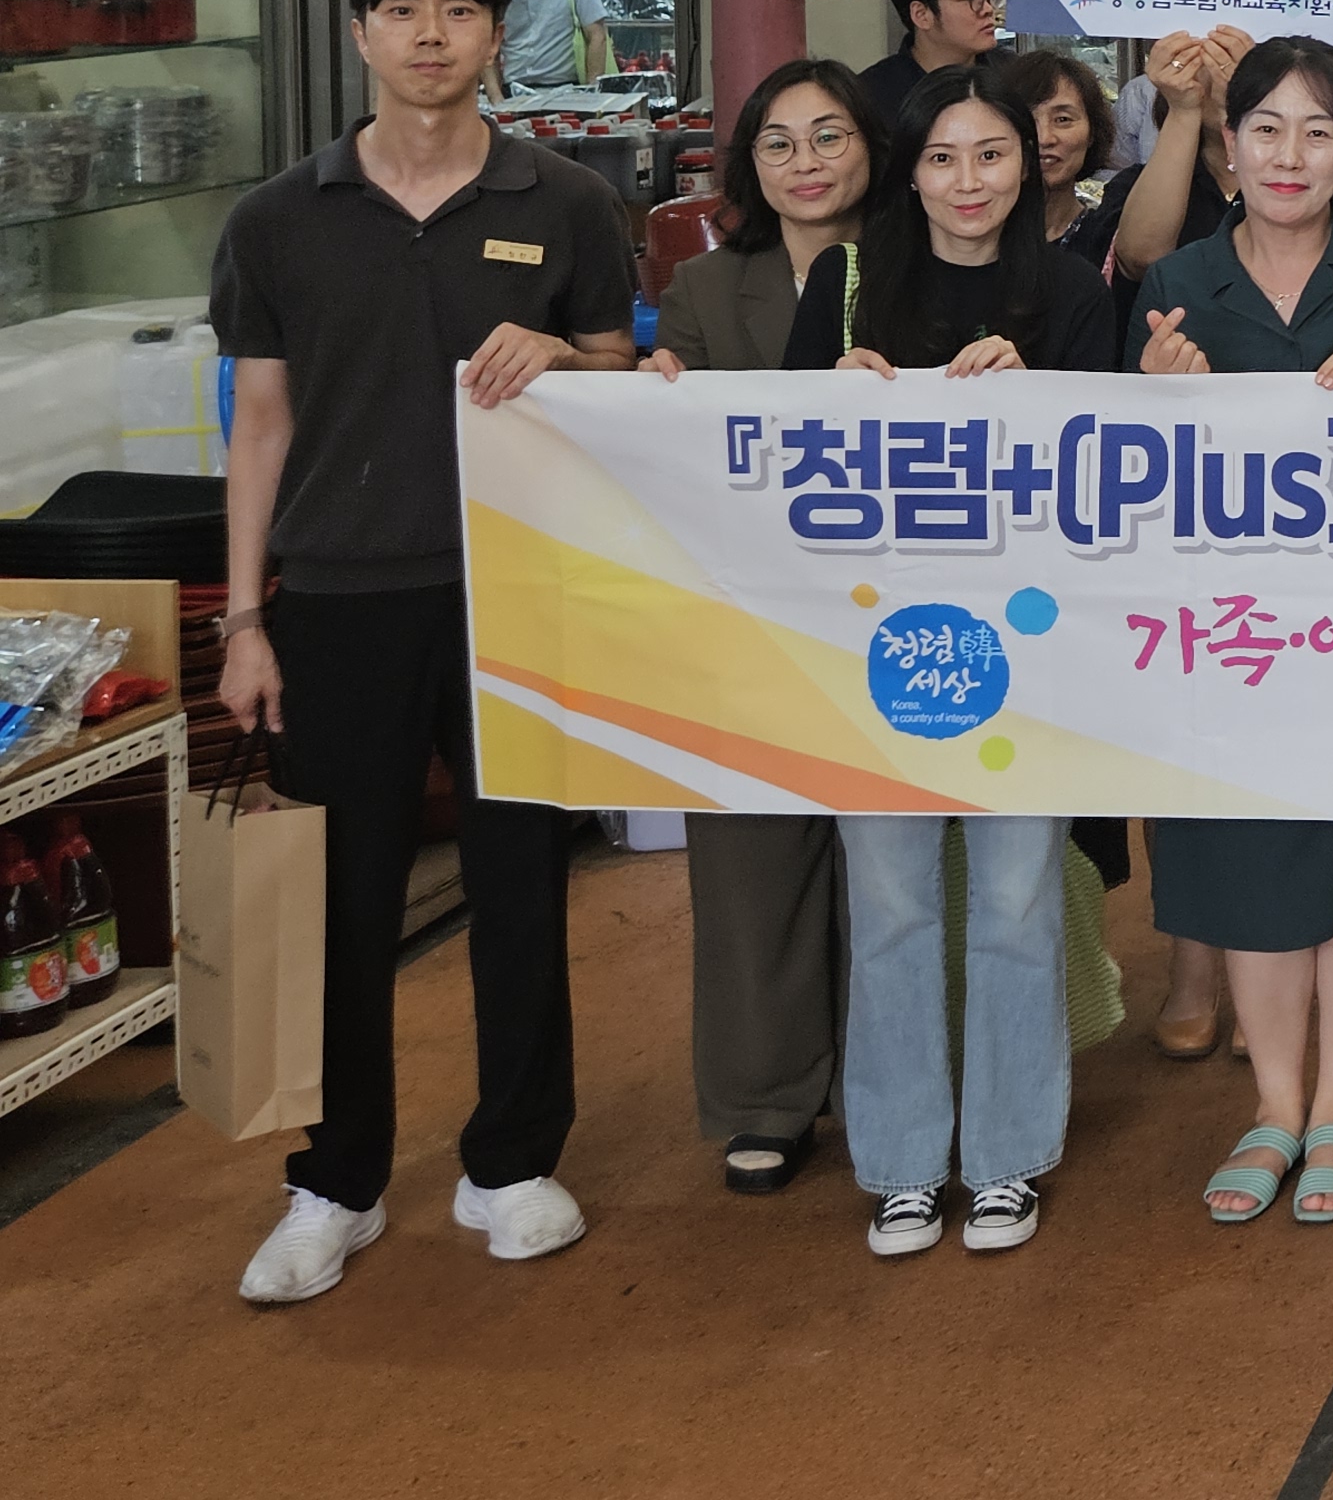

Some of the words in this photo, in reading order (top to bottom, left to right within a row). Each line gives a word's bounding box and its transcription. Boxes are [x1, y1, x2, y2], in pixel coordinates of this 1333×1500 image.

[905, 666, 982, 705] 세상
[891, 699, 923, 712] Korea,
[899, 712, 933, 726] country
[934, 712, 944, 723] of
[945, 712, 981, 726] integrity
